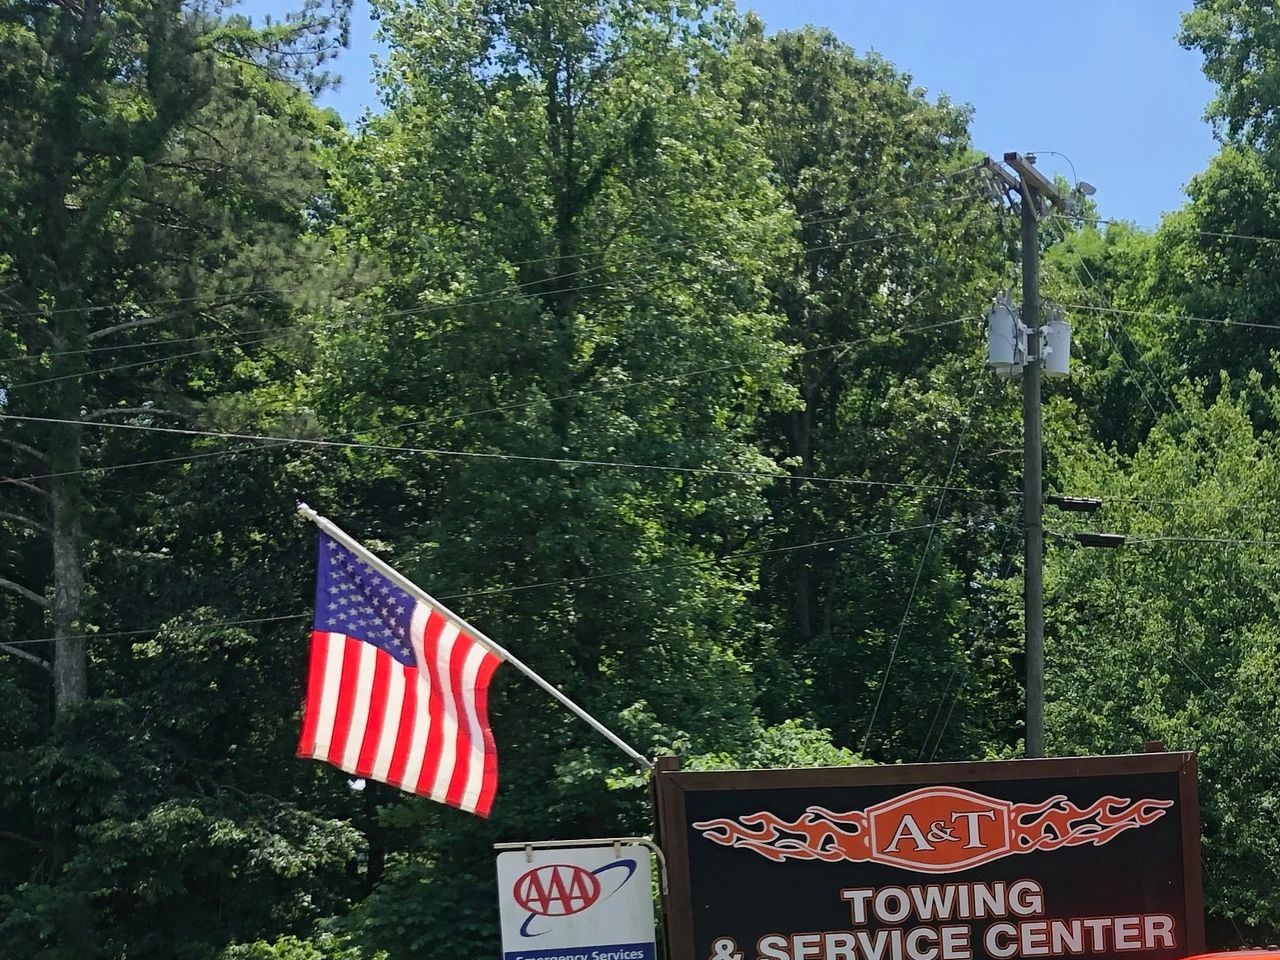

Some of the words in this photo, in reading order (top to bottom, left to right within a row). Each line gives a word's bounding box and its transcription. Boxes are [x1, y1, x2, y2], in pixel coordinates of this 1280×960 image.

[883, 808, 996, 854] A&T
[521, 864, 595, 916] AAA
[841, 879, 1045, 926] TOWING
[985, 914, 1176, 959] CENTER
